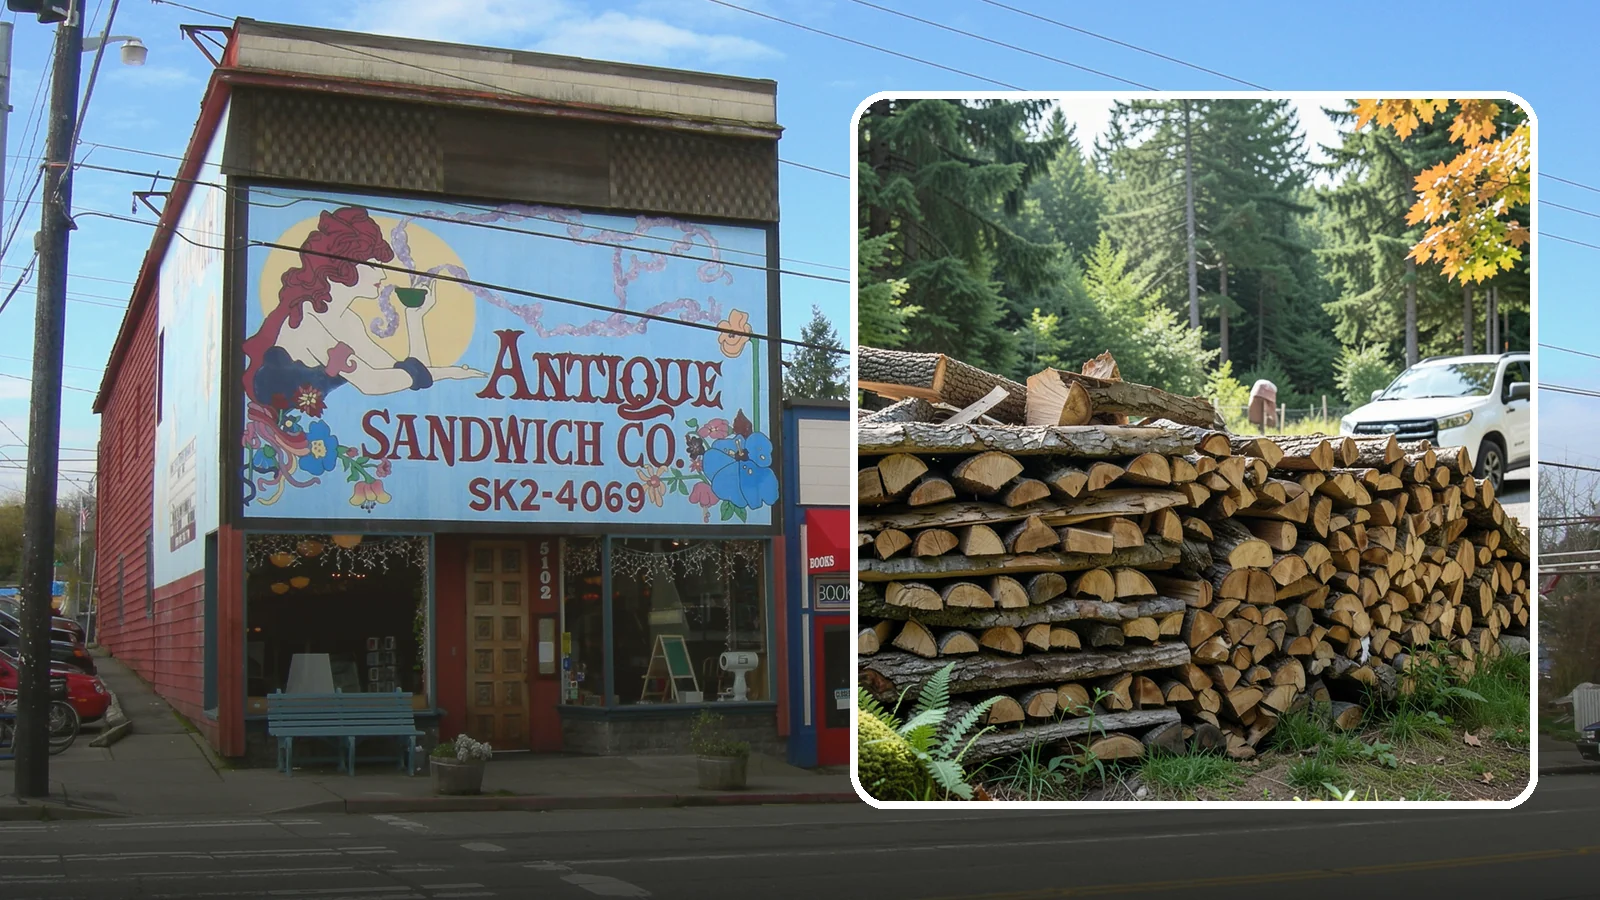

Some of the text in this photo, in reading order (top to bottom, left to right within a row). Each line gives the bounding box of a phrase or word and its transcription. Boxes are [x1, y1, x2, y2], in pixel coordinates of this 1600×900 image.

[475, 329, 723, 421] ANTIQUE
[361, 408, 684, 469] SANDWICH CO.
[468, 477, 645, 513] SK2-4069
[540, 541, 551, 600] 5102
[809, 555, 834, 569] BOOKS
